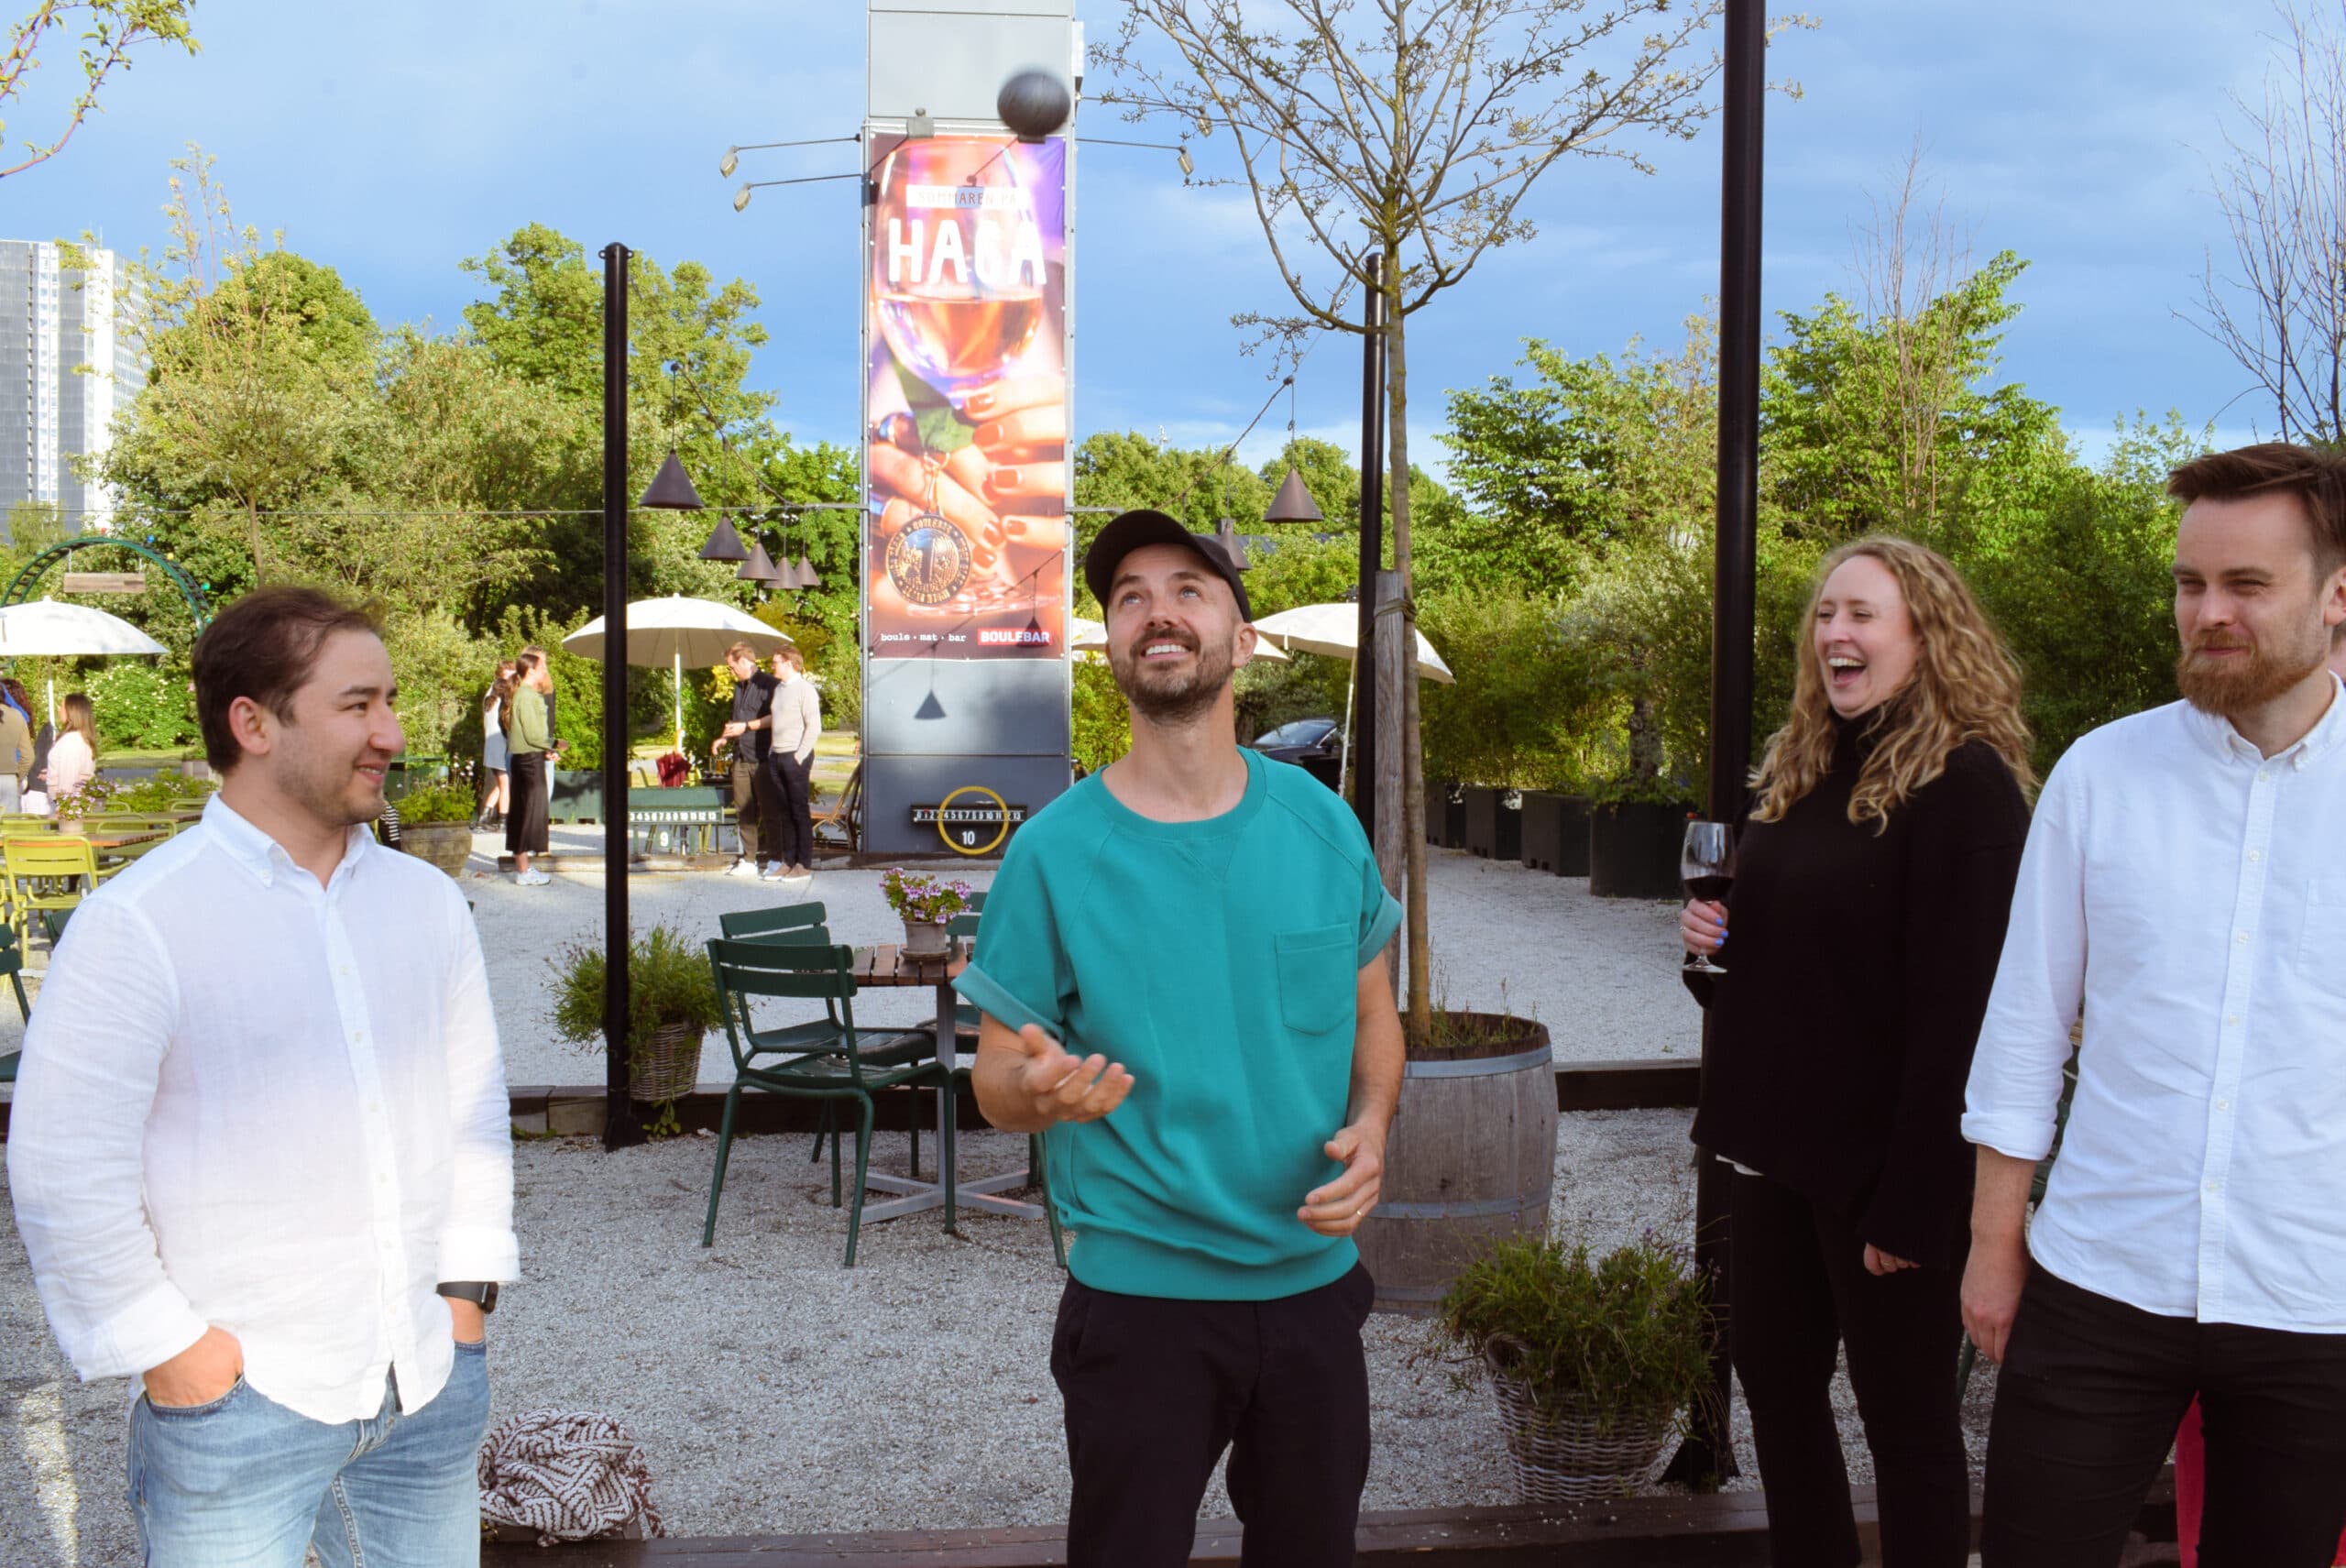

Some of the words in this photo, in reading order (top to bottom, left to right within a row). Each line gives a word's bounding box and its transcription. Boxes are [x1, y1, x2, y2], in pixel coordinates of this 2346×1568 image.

[948, 633, 967, 642] bar
[981, 630, 1050, 643] BOULEBAR
[660, 831, 669, 847] 9
[962, 831, 975, 845] 10
